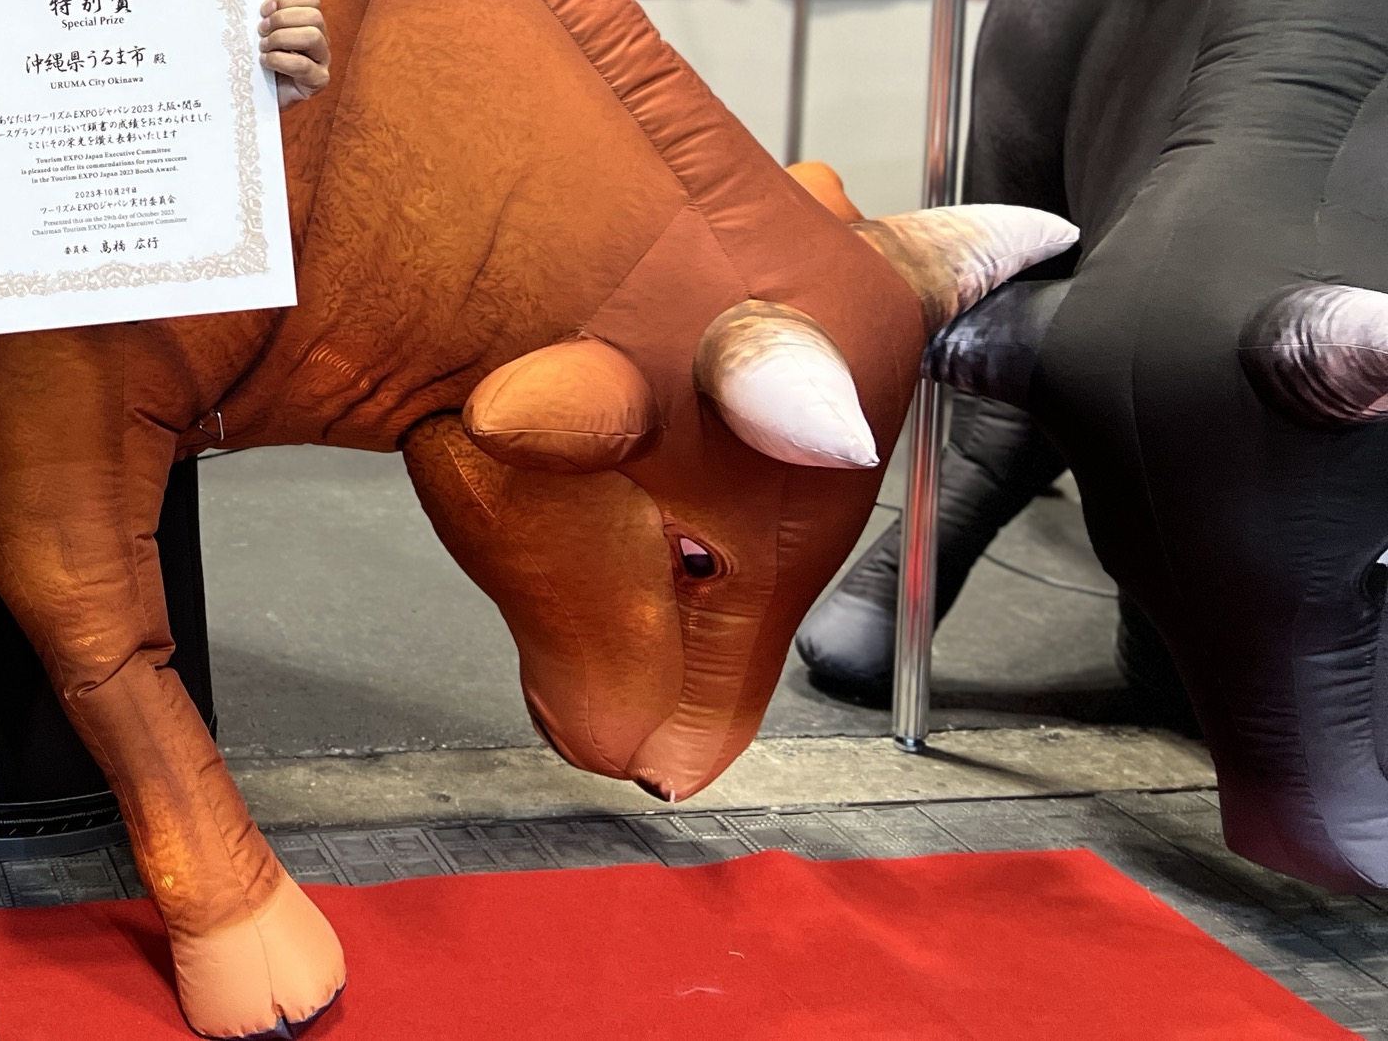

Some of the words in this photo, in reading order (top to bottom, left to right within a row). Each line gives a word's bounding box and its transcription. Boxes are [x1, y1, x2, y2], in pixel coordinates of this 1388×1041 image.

[61, 16, 97, 31] Special
[100, 15, 125, 26] Prize
[25, 45, 146, 74] 沖縄県うるま市
[50, 79, 86, 89] URUMA
[88, 77, 106, 87] City
[107, 75, 144, 85] Okinawa
[36, 156, 62, 164] Tourism
[63, 154, 84, 162] EXPO
[85, 152, 103, 161] Japan
[104, 150, 135, 159] Executive
[136, 147, 171, 156] Committee
[28, 166, 51, 176] pleased
[60, 164, 76, 172] offer
[51, 174, 77, 182] Tourism
[100, 170, 118, 179] Japan
[135, 167, 154, 175] Booth
[75, 186, 137, 198] 2023年10月29日
